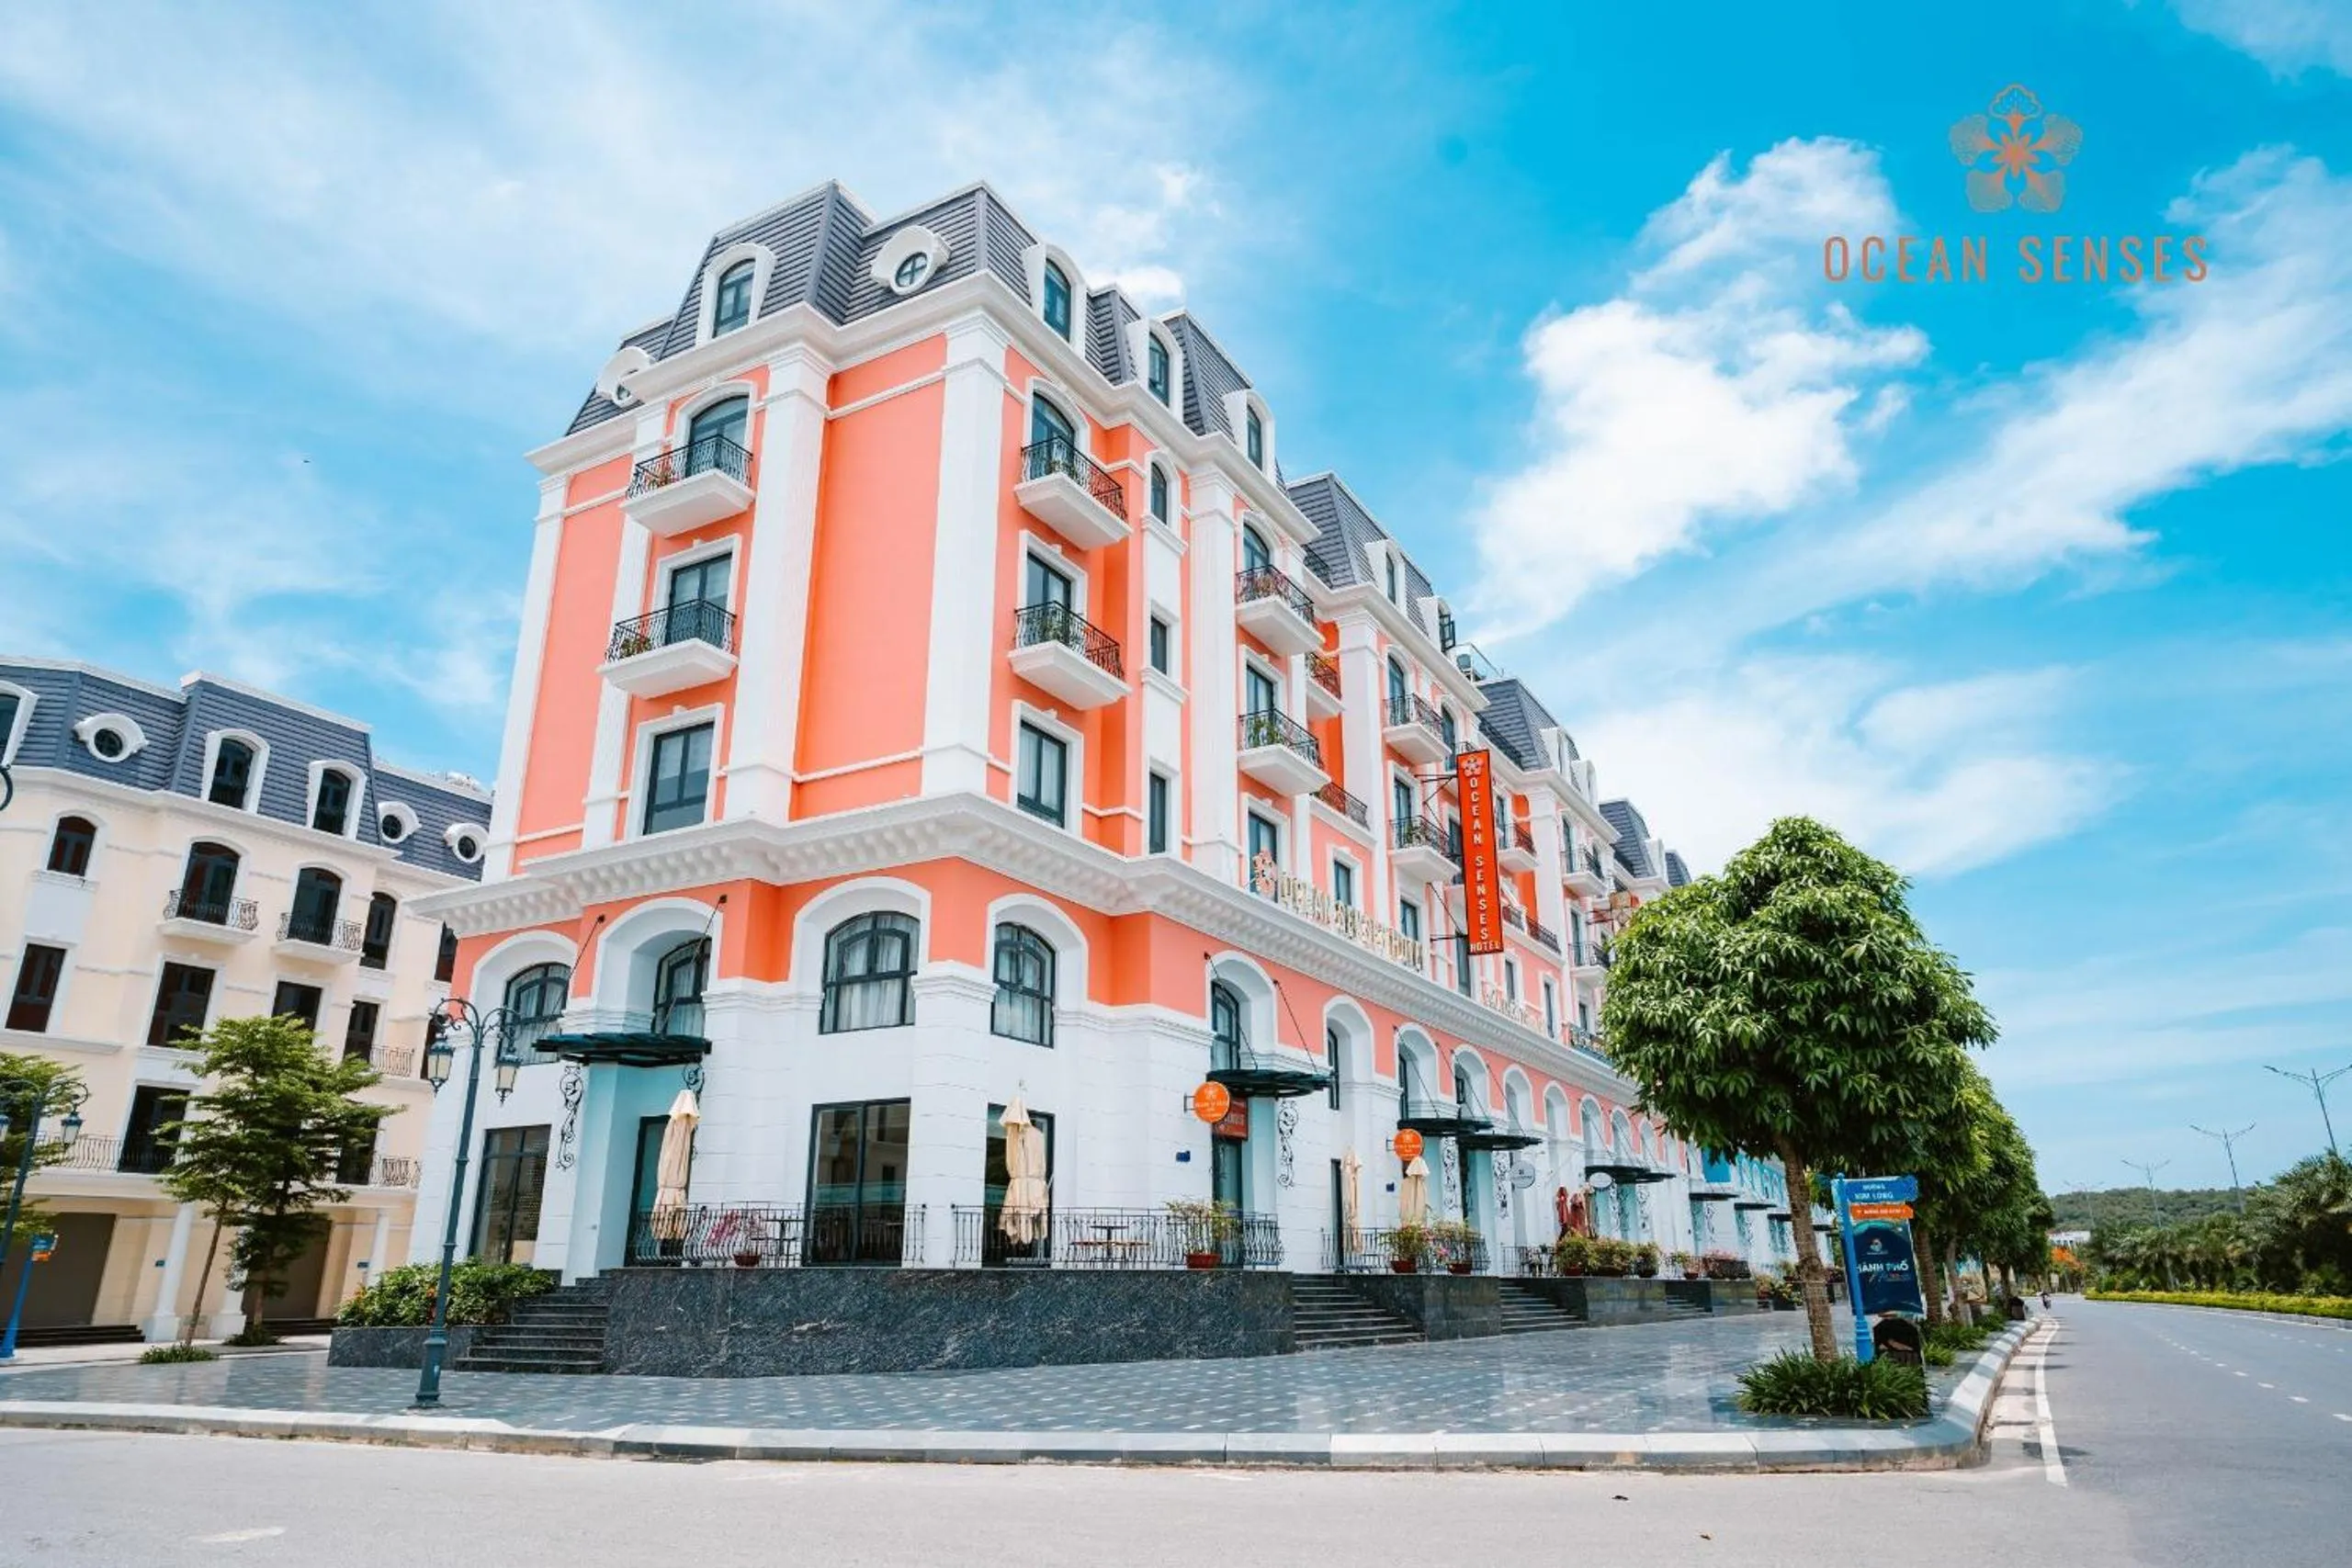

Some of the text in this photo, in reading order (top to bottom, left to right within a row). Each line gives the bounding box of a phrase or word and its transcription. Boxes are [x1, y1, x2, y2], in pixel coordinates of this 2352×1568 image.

[1470, 776, 1488, 941] OCEAN SENSES
[1470, 941, 1501, 953] HOTEL
